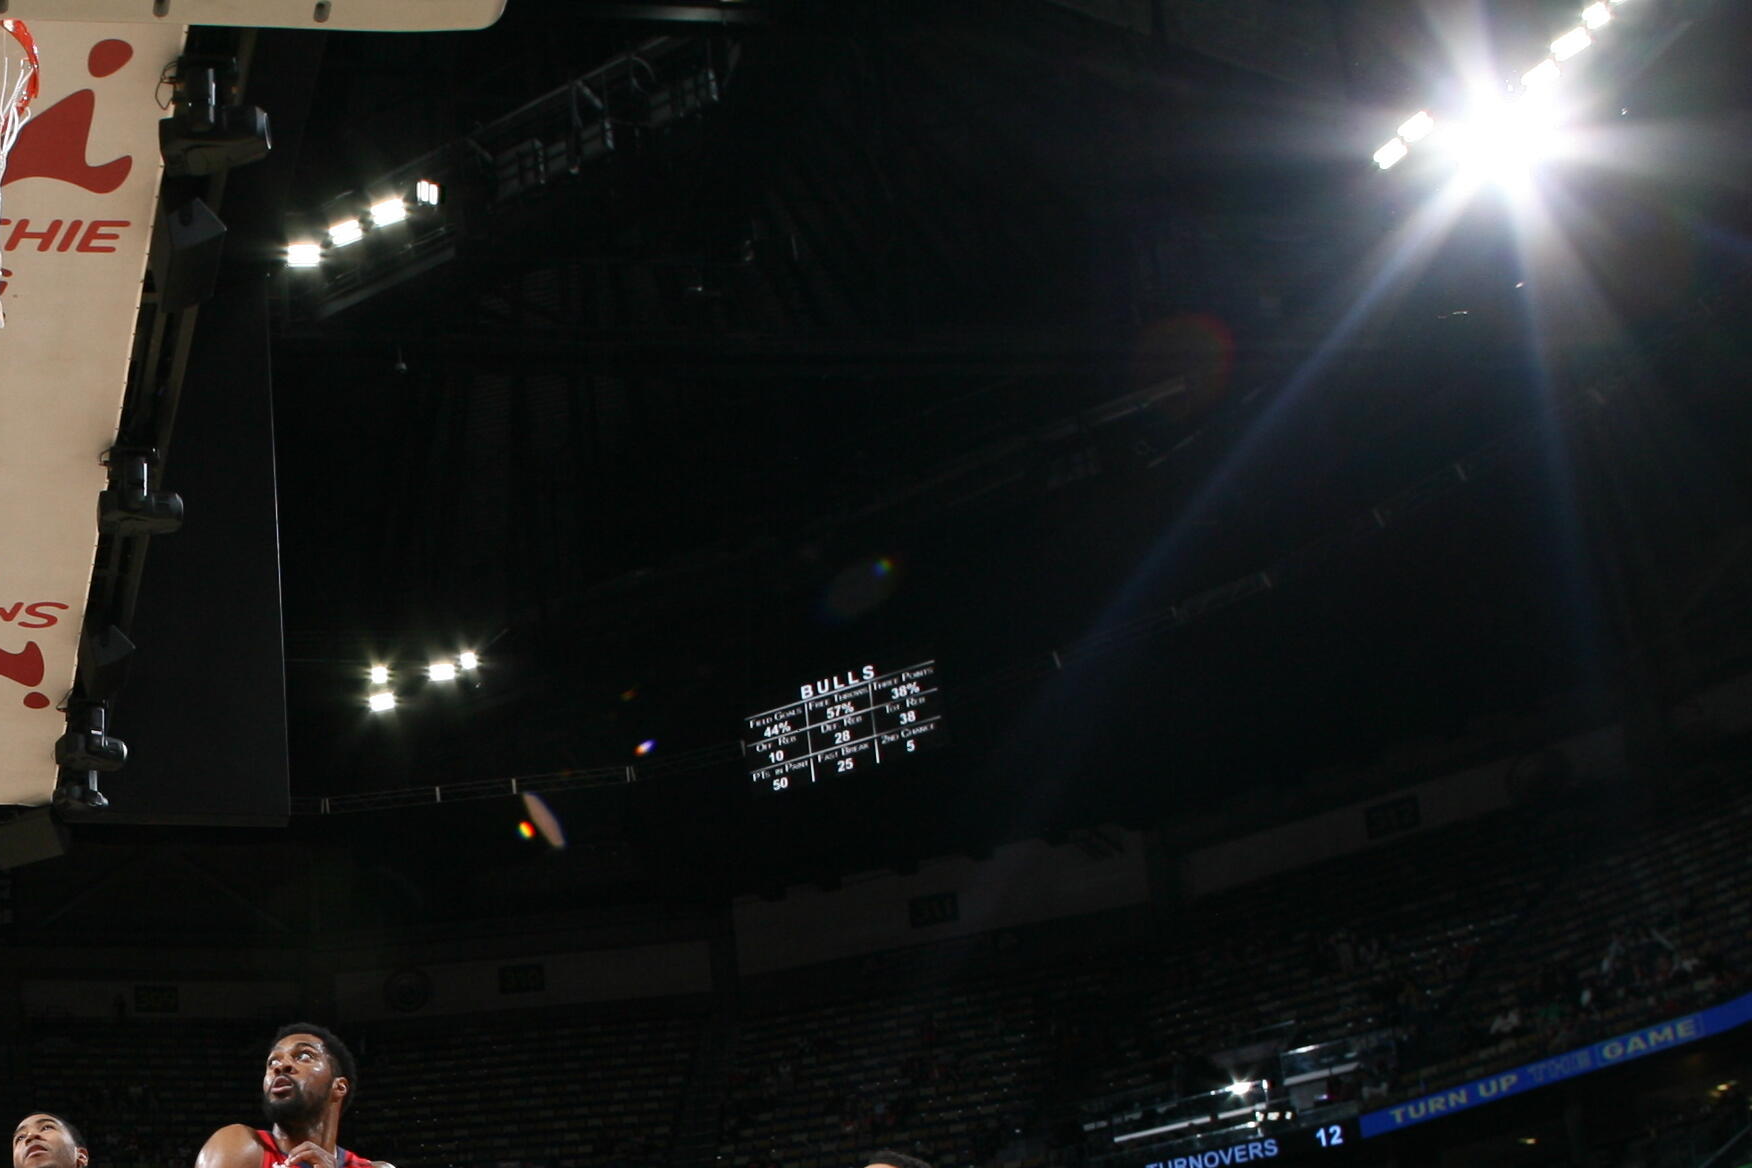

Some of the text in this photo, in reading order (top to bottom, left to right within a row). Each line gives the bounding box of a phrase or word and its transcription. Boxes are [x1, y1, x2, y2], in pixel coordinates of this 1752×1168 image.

[800, 665, 876, 700] BULLS
[891, 682, 921, 700] 38%
[826, 702, 855, 720] 57%
[899, 710, 917, 726] 38
[763, 721, 792, 738] 44%
[834, 730, 851, 745] 28
[905, 738, 916, 752] 5
[768, 750, 785, 764] 10
[837, 758, 854, 773] 25
[772, 777, 789, 792] 50
[1389, 1087, 1468, 1125] TURN
[1477, 1074, 1519, 1099] UP
[1601, 1017, 1698, 1062] GAME
[1315, 1125, 1344, 1148] 12
